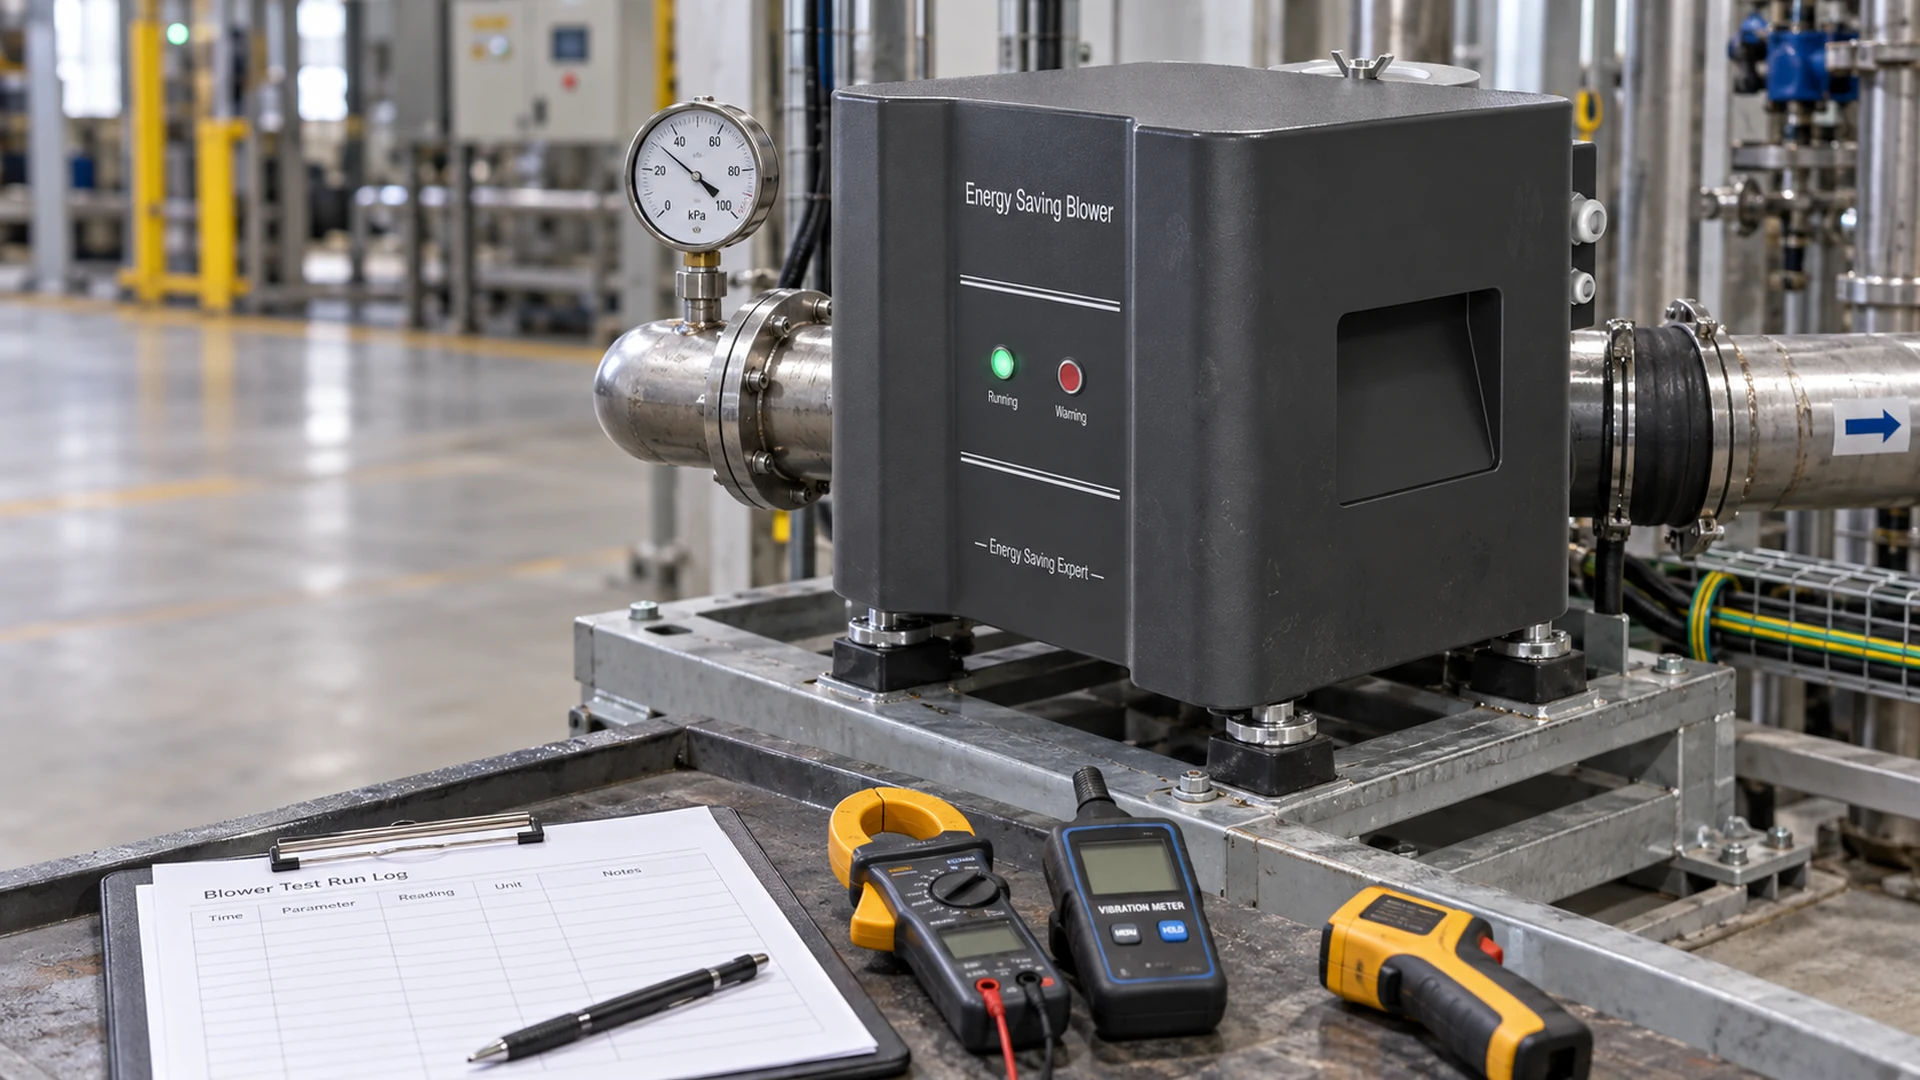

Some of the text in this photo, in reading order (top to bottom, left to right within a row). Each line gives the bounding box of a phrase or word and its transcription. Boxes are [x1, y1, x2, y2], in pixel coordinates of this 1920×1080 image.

[674, 136, 686, 147] 40
[709, 136, 721, 147] 60
[654, 166, 666, 176] 20
[728, 166, 740, 176] 80
[665, 200, 671, 211] 0
[716, 200, 732, 211] 100
[965, 181, 1114, 223] Energy Saving Blower
[688, 210, 706, 221] kPa
[988, 390, 1018, 411] Running
[1055, 405, 1087, 426] Warning
[990, 538, 1089, 580] Energy Saving Expert
[204, 870, 409, 900] Blower Test Run Log
[209, 867, 642, 922] Time Parameter Reading Unit Notes
[1098, 902, 1185, 914] VIBRATION METER
